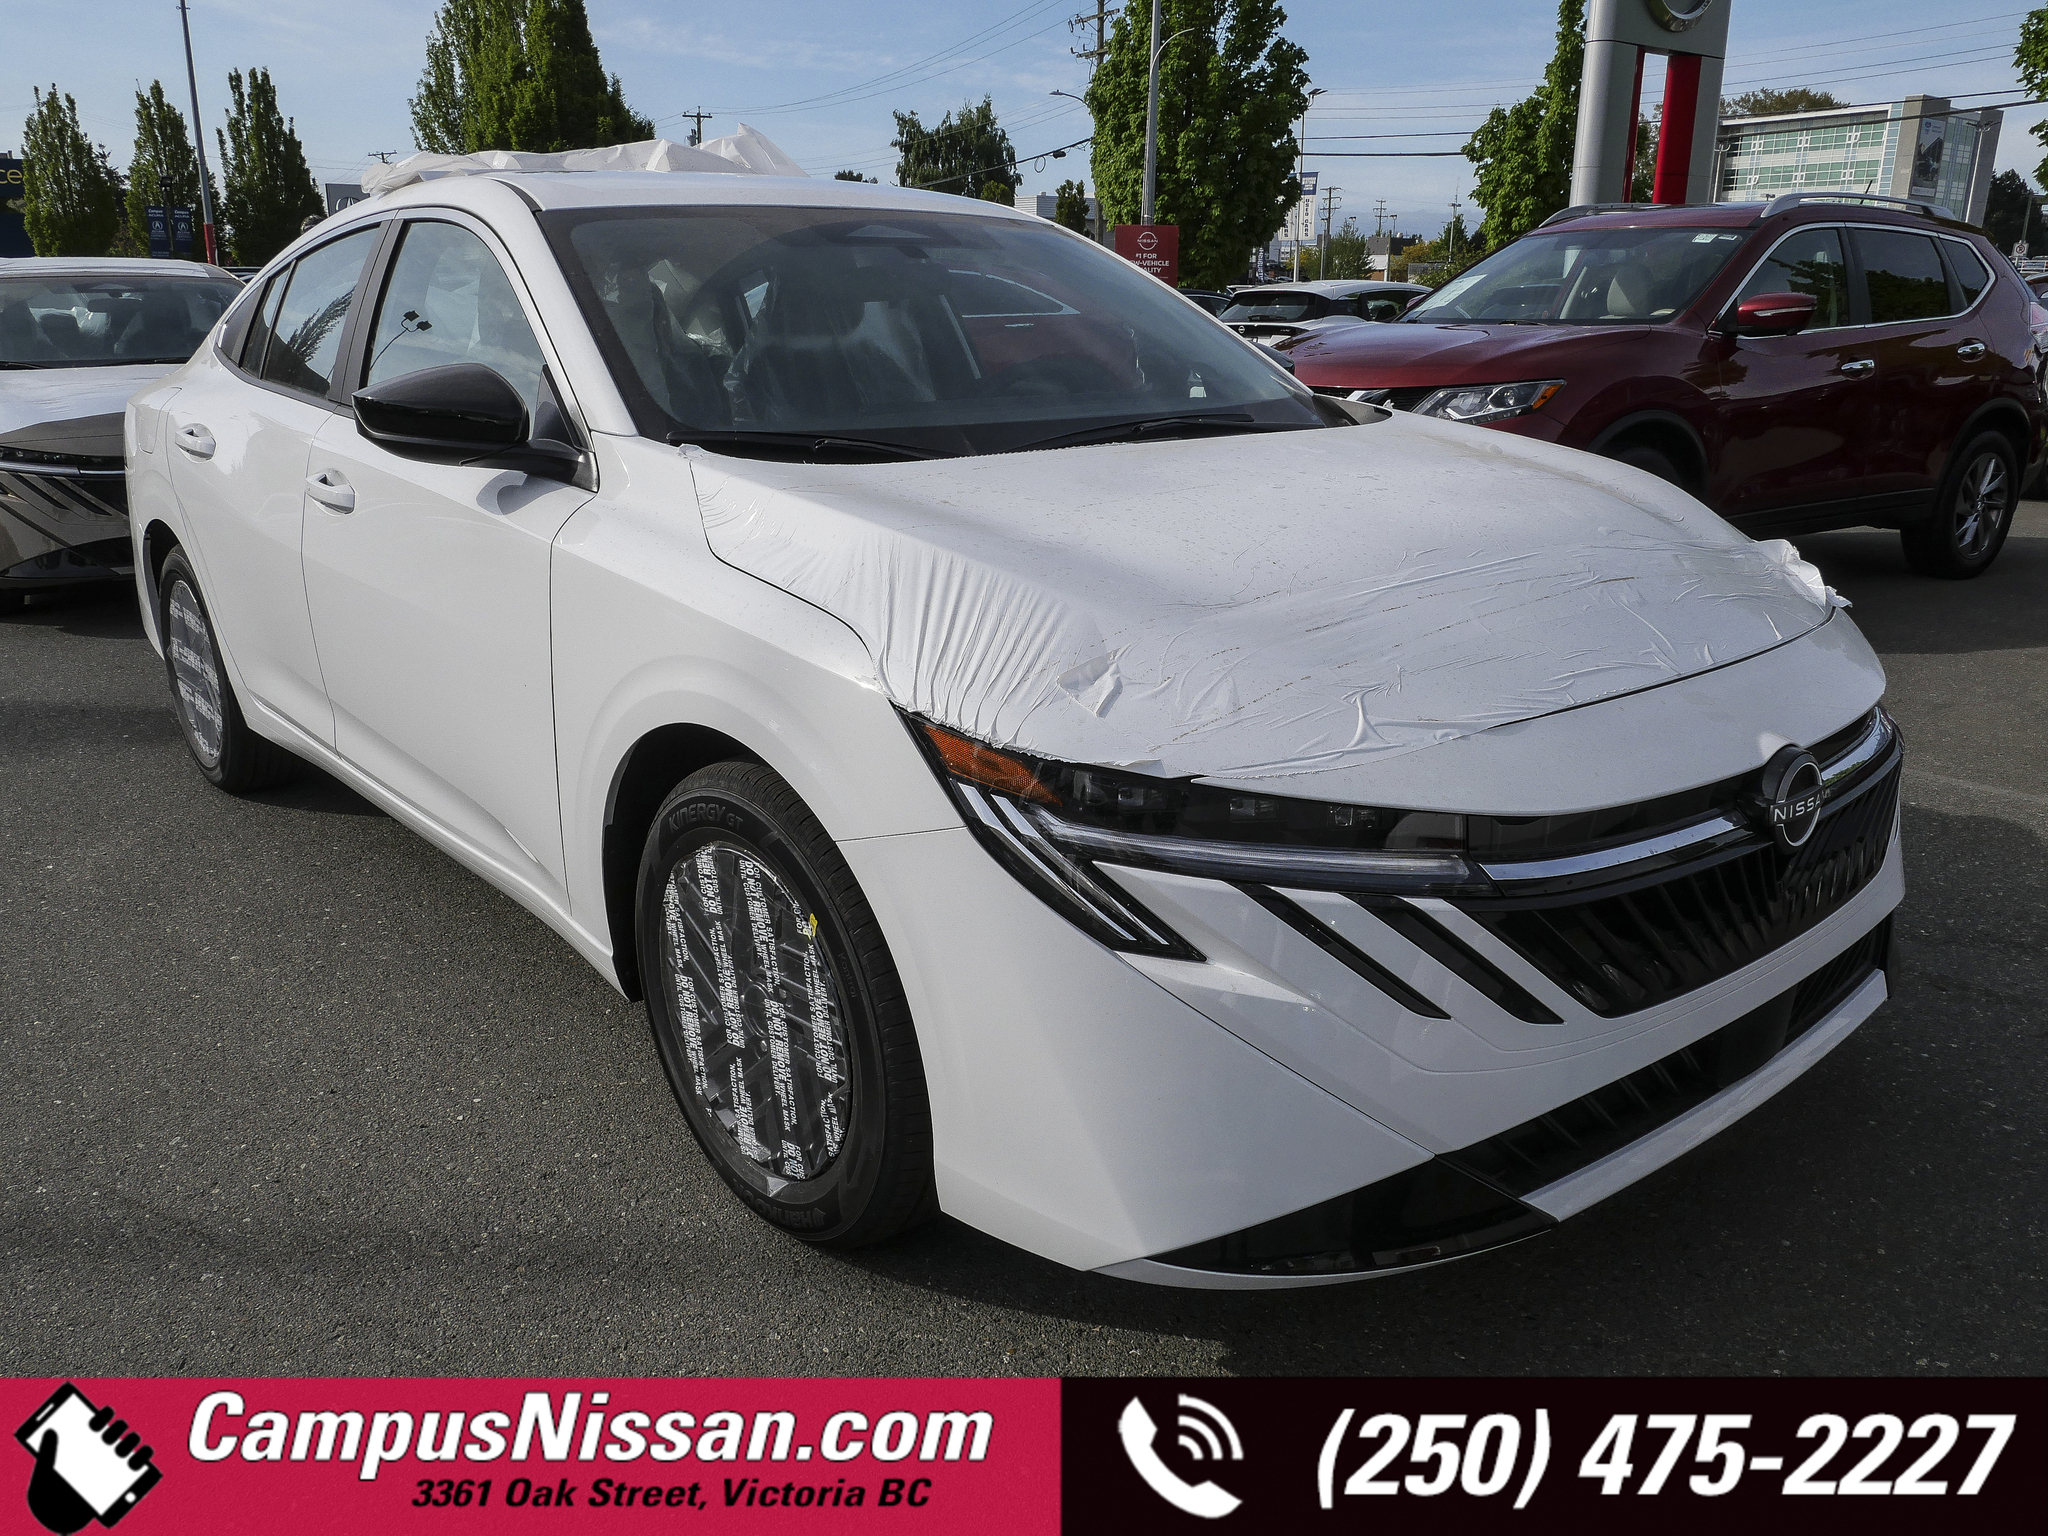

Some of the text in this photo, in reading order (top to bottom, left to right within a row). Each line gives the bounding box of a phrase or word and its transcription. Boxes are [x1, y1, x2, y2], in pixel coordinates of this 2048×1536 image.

[745, 860, 754, 876] DO
[705, 877, 716, 898] NOT
[747, 877, 760, 899] NOT
[752, 900, 769, 943] REMOVE
[683, 990, 693, 1009] NOT
[723, 968, 736, 1010] REMOVE
[769, 1000, 780, 1015] DO
[685, 1010, 698, 1049] REMOVE
[728, 1010, 740, 1031] NOT
[772, 1016, 784, 1039] NOT
[813, 997, 828, 1042] REMOVE
[732, 1031, 741, 1047] DO
[775, 1039, 787, 1082] REMOVE
